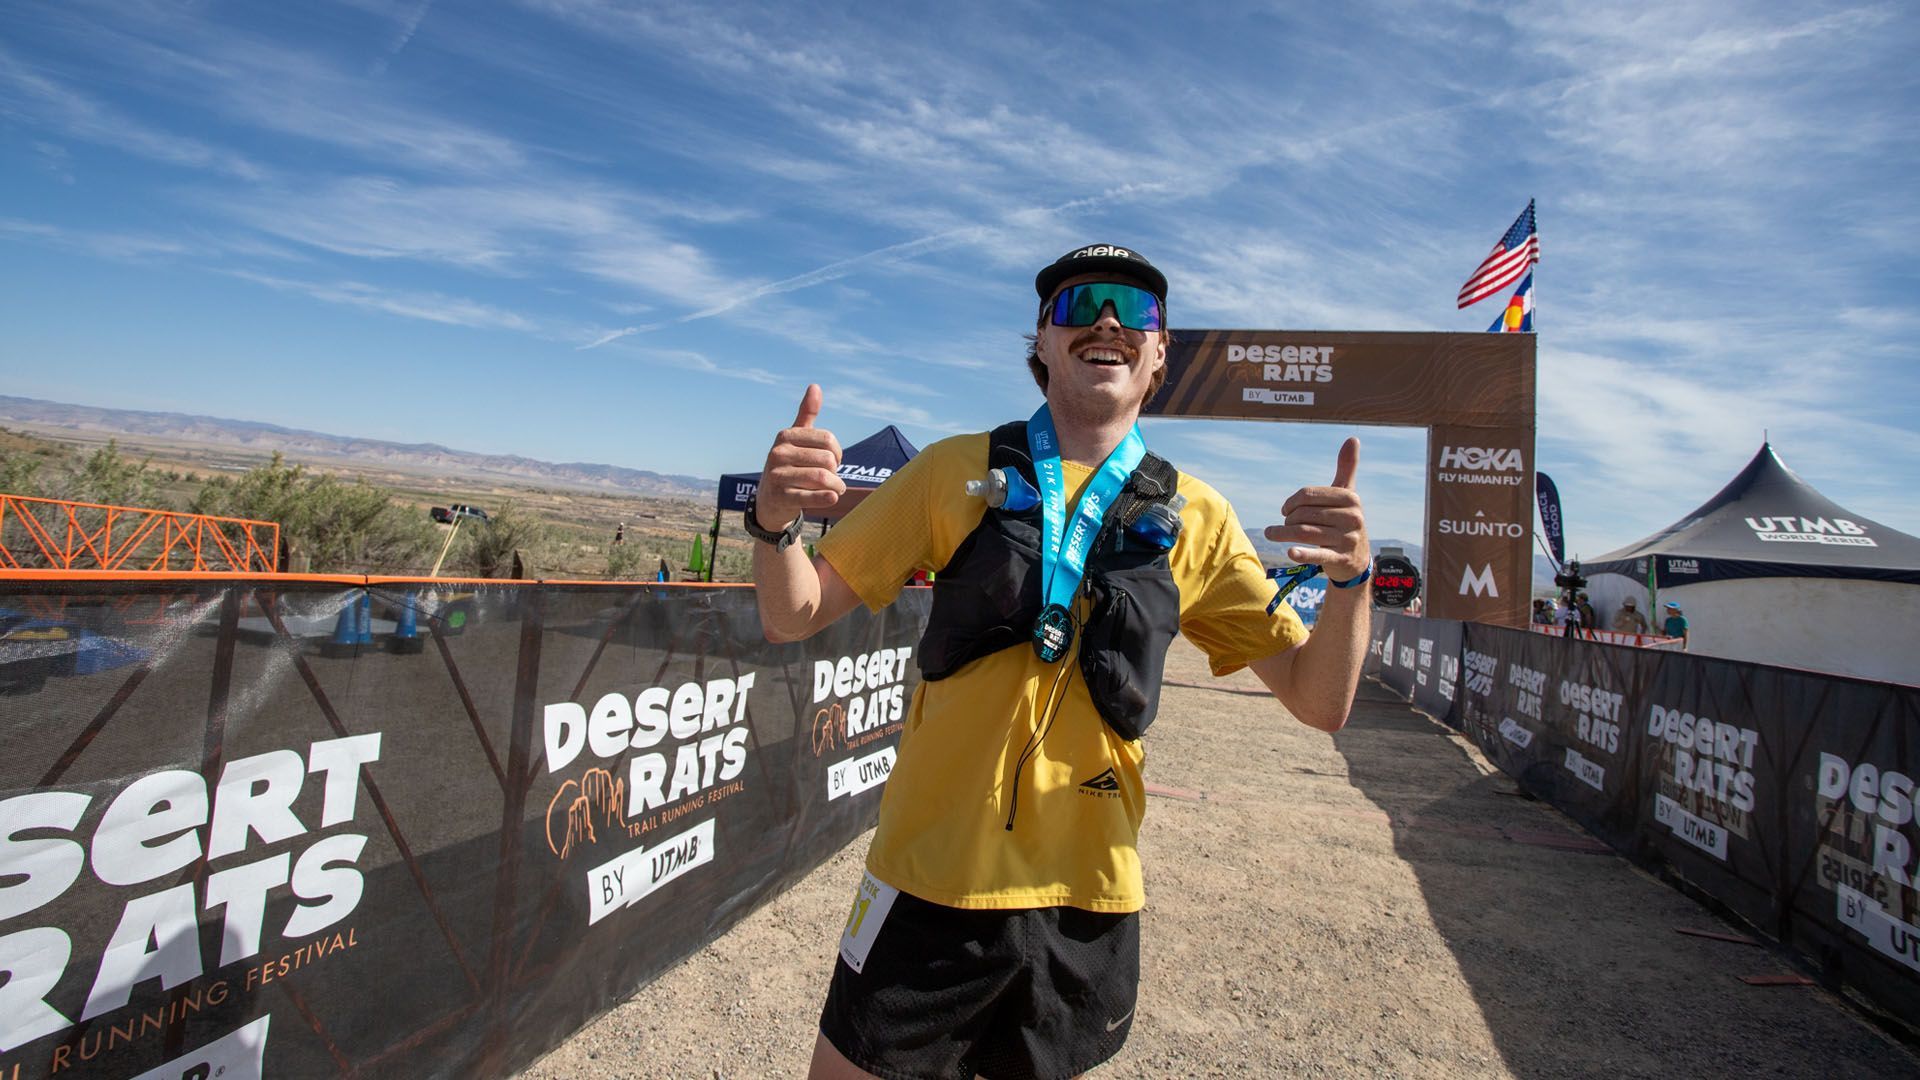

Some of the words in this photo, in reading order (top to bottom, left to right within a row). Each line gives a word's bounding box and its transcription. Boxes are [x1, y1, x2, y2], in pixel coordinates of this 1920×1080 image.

[1073, 246, 1129, 258] ciele
[1263, 363, 1333, 383] RATS
[1248, 390, 1261, 399] BY
[1274, 393, 1305, 403] UTMB
[1439, 446, 1523, 471] HOKA
[1043, 463, 1056, 485] 21K
[1438, 473, 1456, 483] FLY
[1458, 474, 1502, 485] HUMAN
[1503, 476, 1522, 486] FLY
[1049, 489, 1060, 551] FINISHER
[1438, 519, 1523, 538] SUUNTO
[1550, 504, 1561, 537] FOOD
[1744, 517, 1865, 535] UTMB
[1824, 536, 1871, 545] SERIES
[1668, 559, 1699, 568] UTMB
[1285, 586, 1327, 609] HOK
[1463, 648, 1498, 677] eSeRT
[847, 684, 904, 737] RATS
[1578, 713, 1620, 754] RATS
[628, 727, 749, 817] RATS
[833, 767, 846, 790] BY
[859, 756, 891, 784] UTMB
[1674, 750, 1756, 813] RATS
[1078, 788, 1103, 799] NIKE
[628, 818, 658, 838] TRAIL
[661, 795, 704, 824] RUNNING
[708, 780, 745, 803] FESTIVAL
[1659, 799, 1672, 820] BY
[1684, 817, 1716, 848] UTMB
[602, 865, 624, 905] BY
[652, 835, 698, 884] UTMB
[1847, 895, 1867, 924] BY
[53, 981, 228, 1073] RUNNING
[246, 927, 358, 991] FESTIVAL
